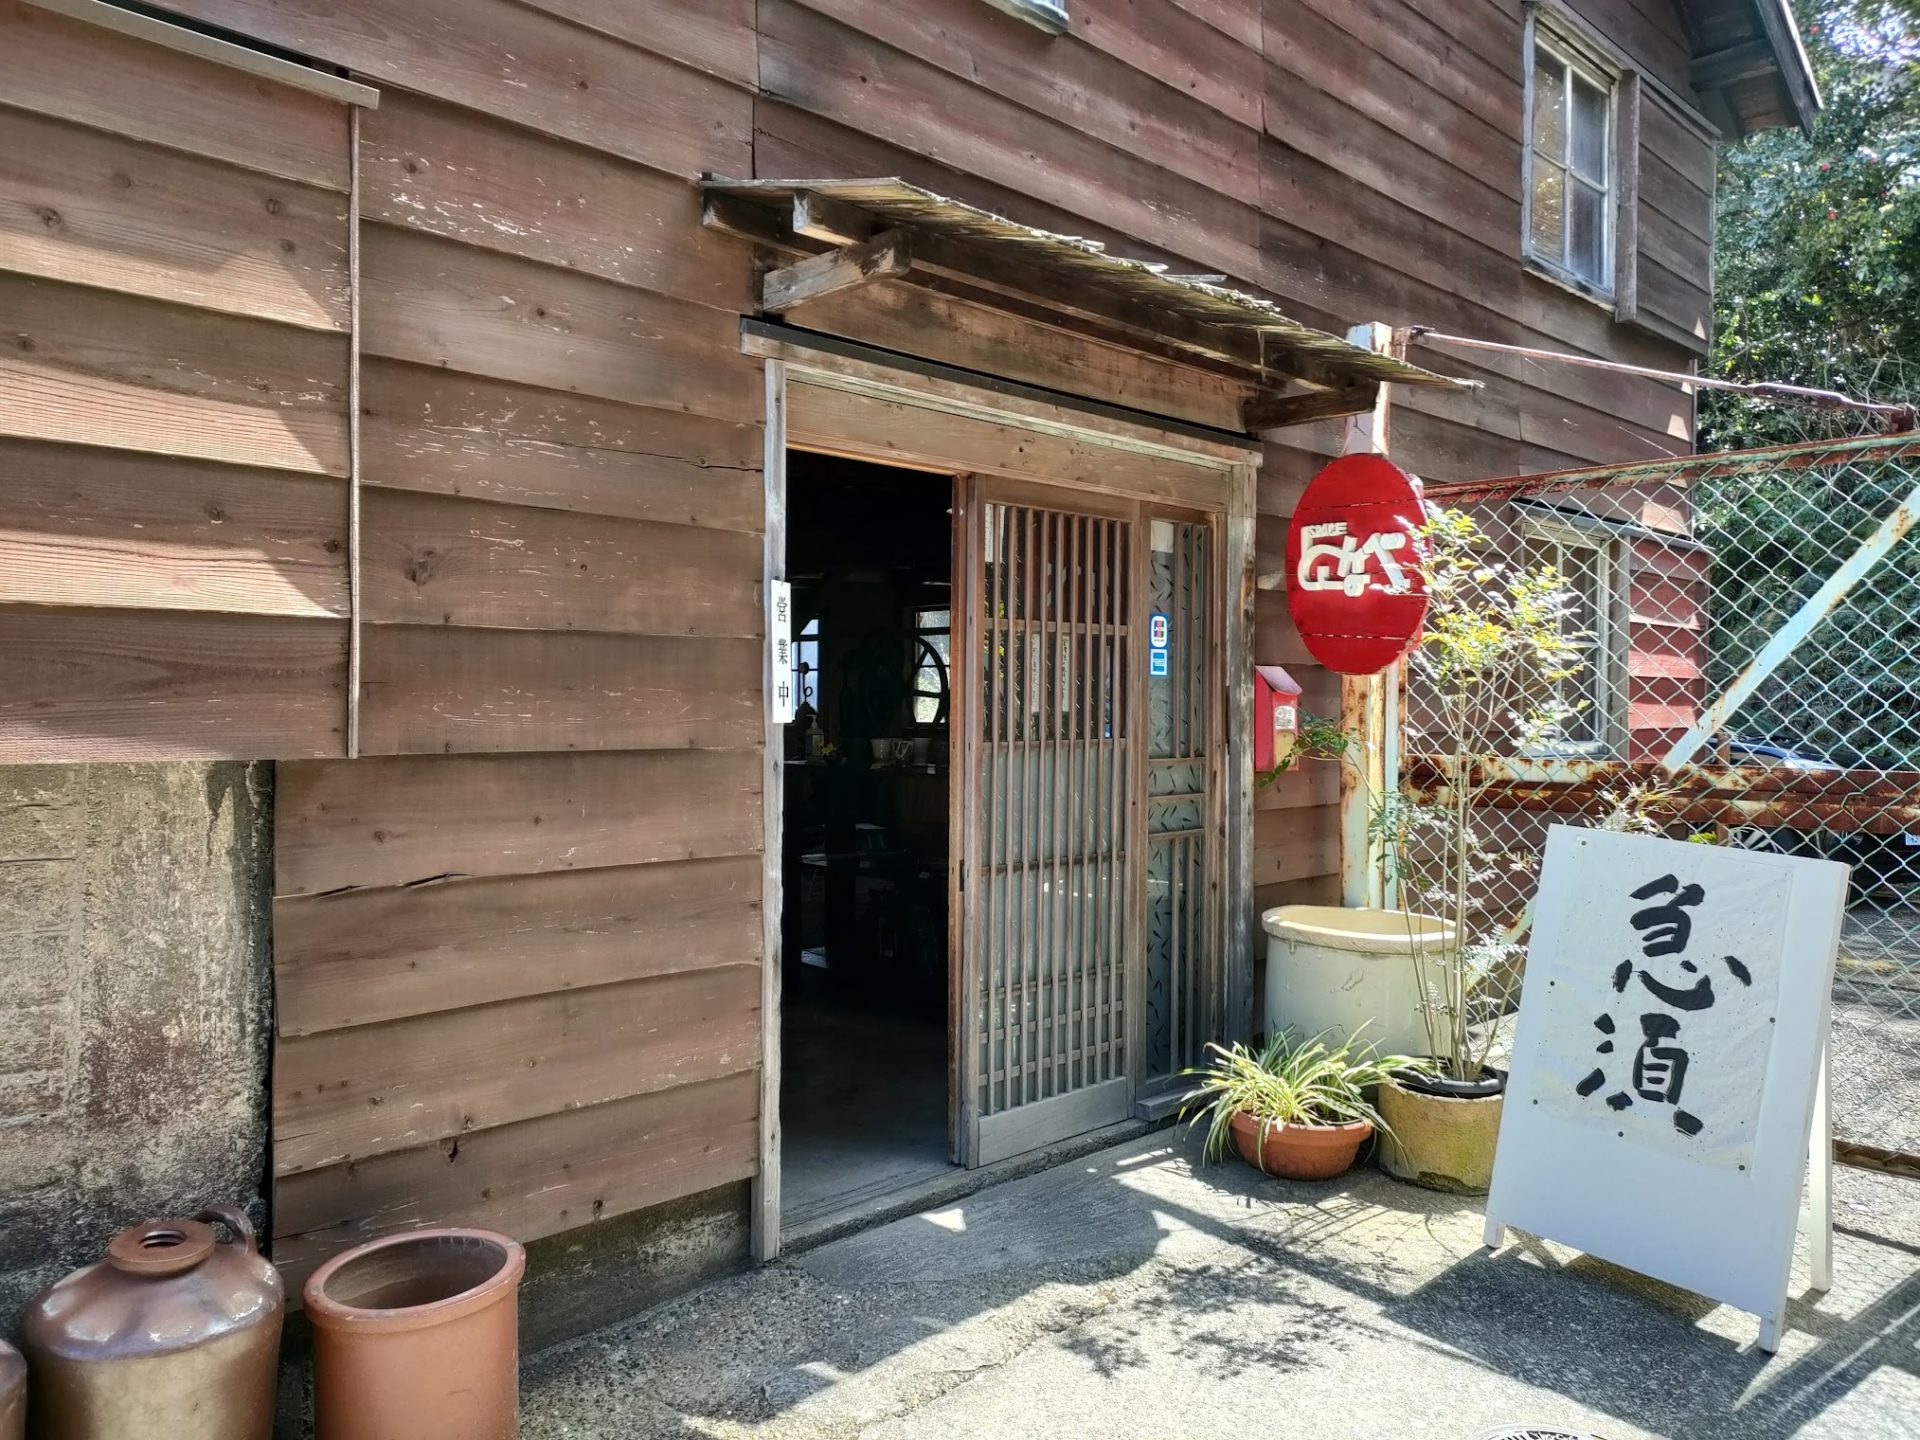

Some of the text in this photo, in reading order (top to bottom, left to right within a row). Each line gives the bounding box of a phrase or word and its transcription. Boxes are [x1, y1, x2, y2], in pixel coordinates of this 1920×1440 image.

[776, 596, 789, 707] 営業中
[1575, 873, 1753, 1139] 急須
